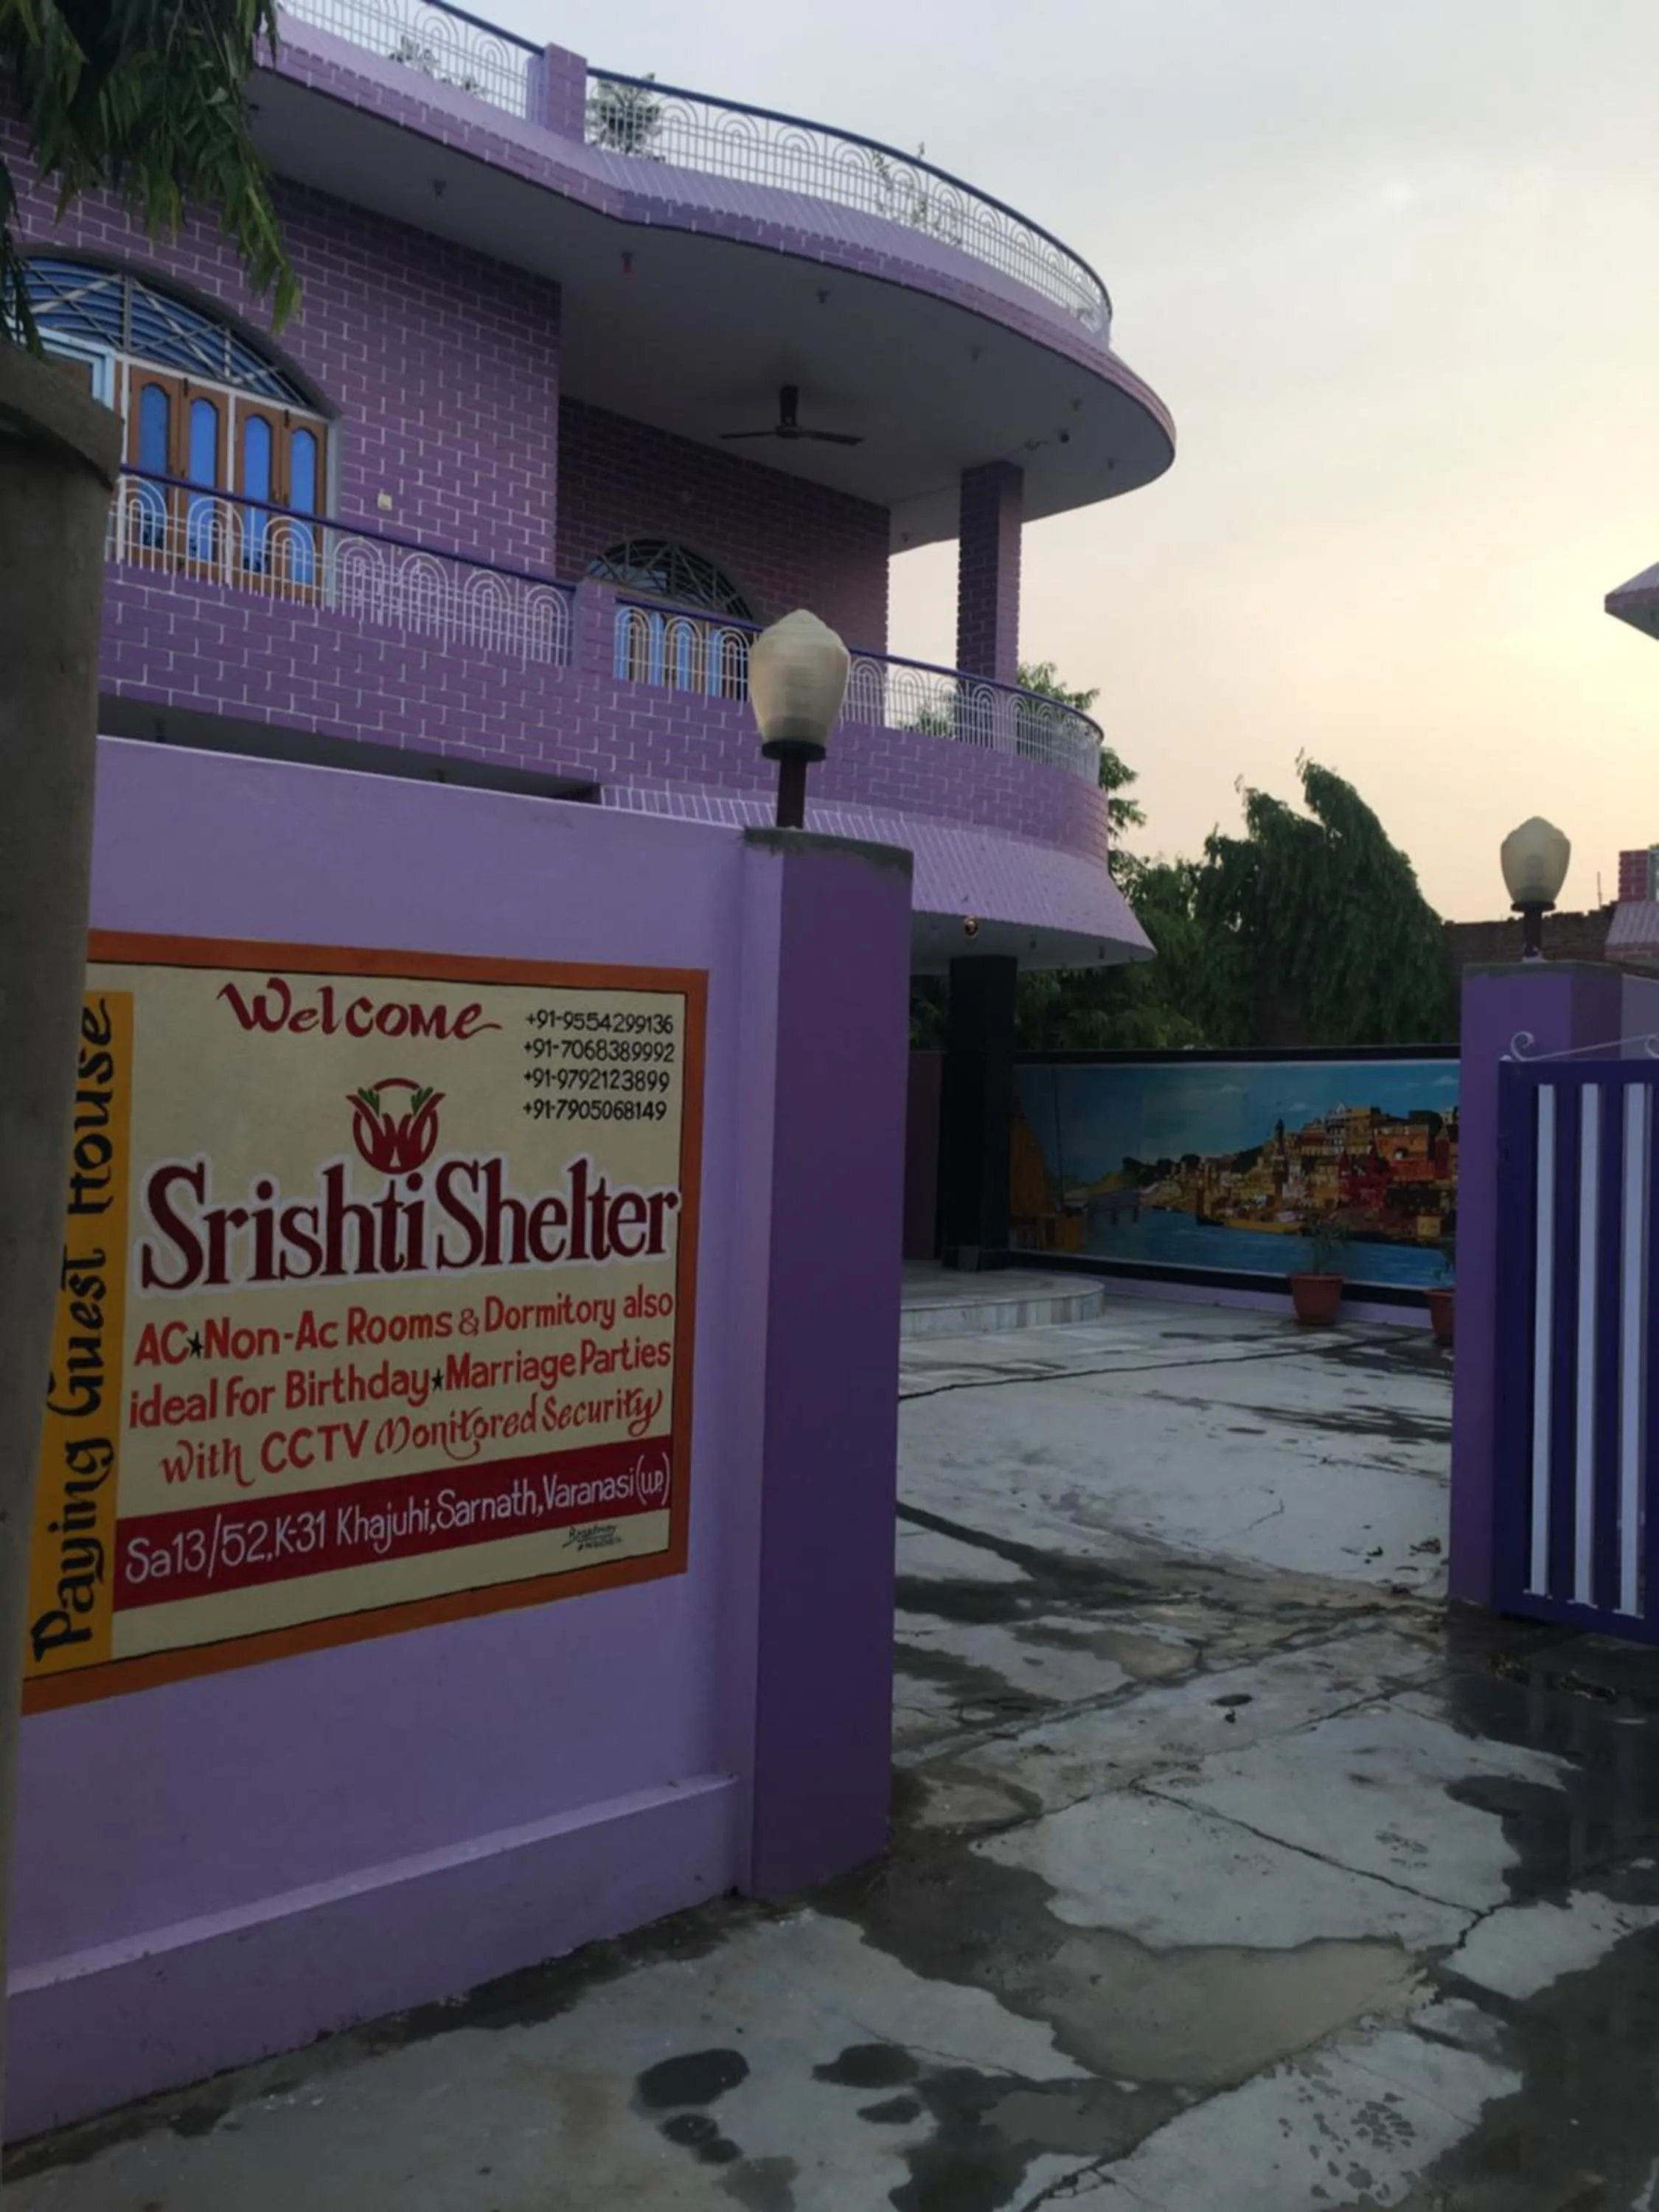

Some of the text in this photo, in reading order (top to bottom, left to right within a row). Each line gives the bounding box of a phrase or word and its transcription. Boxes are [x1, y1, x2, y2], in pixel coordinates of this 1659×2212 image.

[216, 977, 503, 1040] Welcome
[526, 1009, 674, 1034] +91-9554299136
[524, 1037, 675, 1062] +91-7068389992
[524, 1068, 670, 1093] +91-9792123899
[67, 998, 115, 1215] House
[523, 1099, 667, 1121] +91-7905068149
[142, 1158, 679, 1290] Srishti Shelter
[347, 1305, 453, 1346] Rooms
[457, 1307, 481, 1338] &
[484, 1292, 616, 1331] Dormitory
[623, 1283, 674, 1319] also
[129, 1337, 672, 1429] ideal for Birthday Marriage Parties
[159, 1388, 664, 1489] with CCTV Monitored Security
[29, 1438, 115, 1662] Paying
